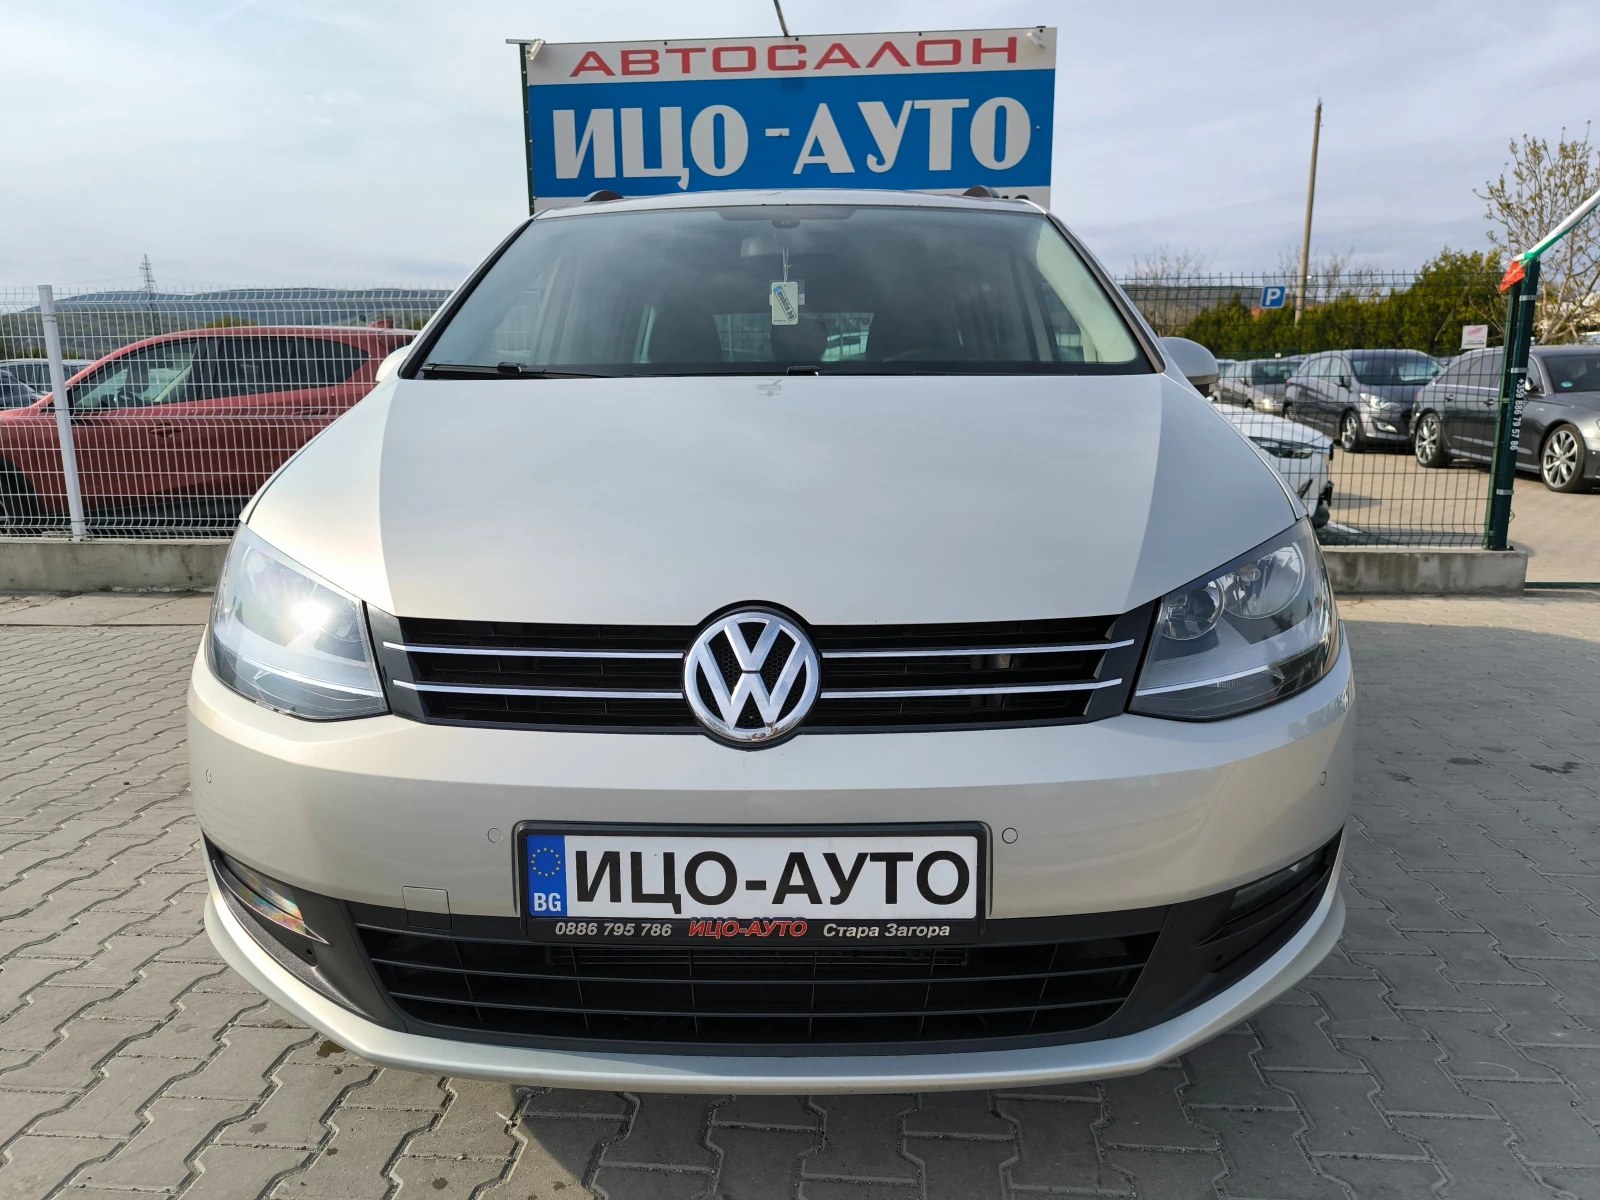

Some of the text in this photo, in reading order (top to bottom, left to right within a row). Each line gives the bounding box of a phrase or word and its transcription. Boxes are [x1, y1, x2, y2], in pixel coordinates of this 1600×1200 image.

[569, 36, 1018, 78] АВТОСАЛОН
[776, 290, 796, 320] mobile.bg
[1264, 287, 1282, 306] P
[1509, 378, 1525, 451] +359 886 79 57 86
[575, 849, 970, 915] ИЦО-АУТО
[533, 892, 562, 912] BG
[555, 919, 951, 939] 0886 795 786 ИЦО-АУТО Стара Загора
